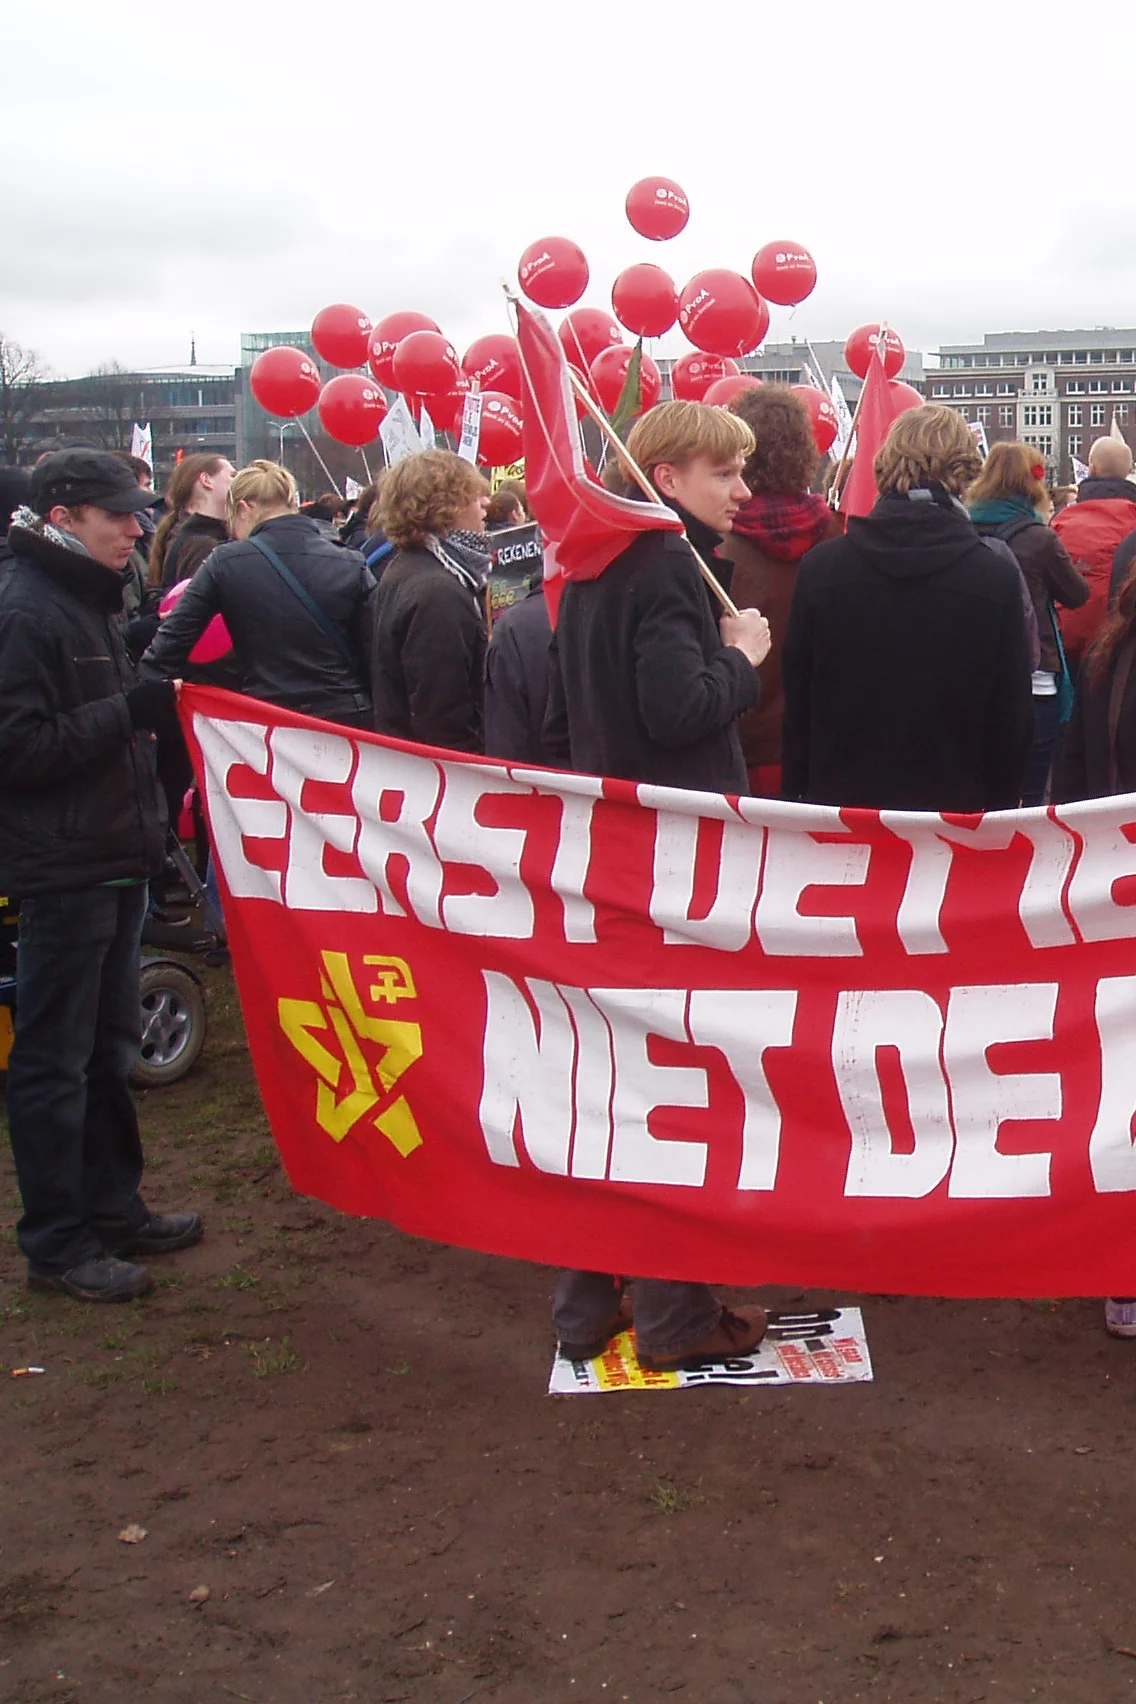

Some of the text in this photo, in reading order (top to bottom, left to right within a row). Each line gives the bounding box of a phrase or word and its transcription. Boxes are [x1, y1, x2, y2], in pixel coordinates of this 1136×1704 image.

[192, 711, 604, 943] EERST
[637, 784, 871, 957] DE
[479, 969, 798, 1191] NIET
[831, 983, 1063, 1198] DE
